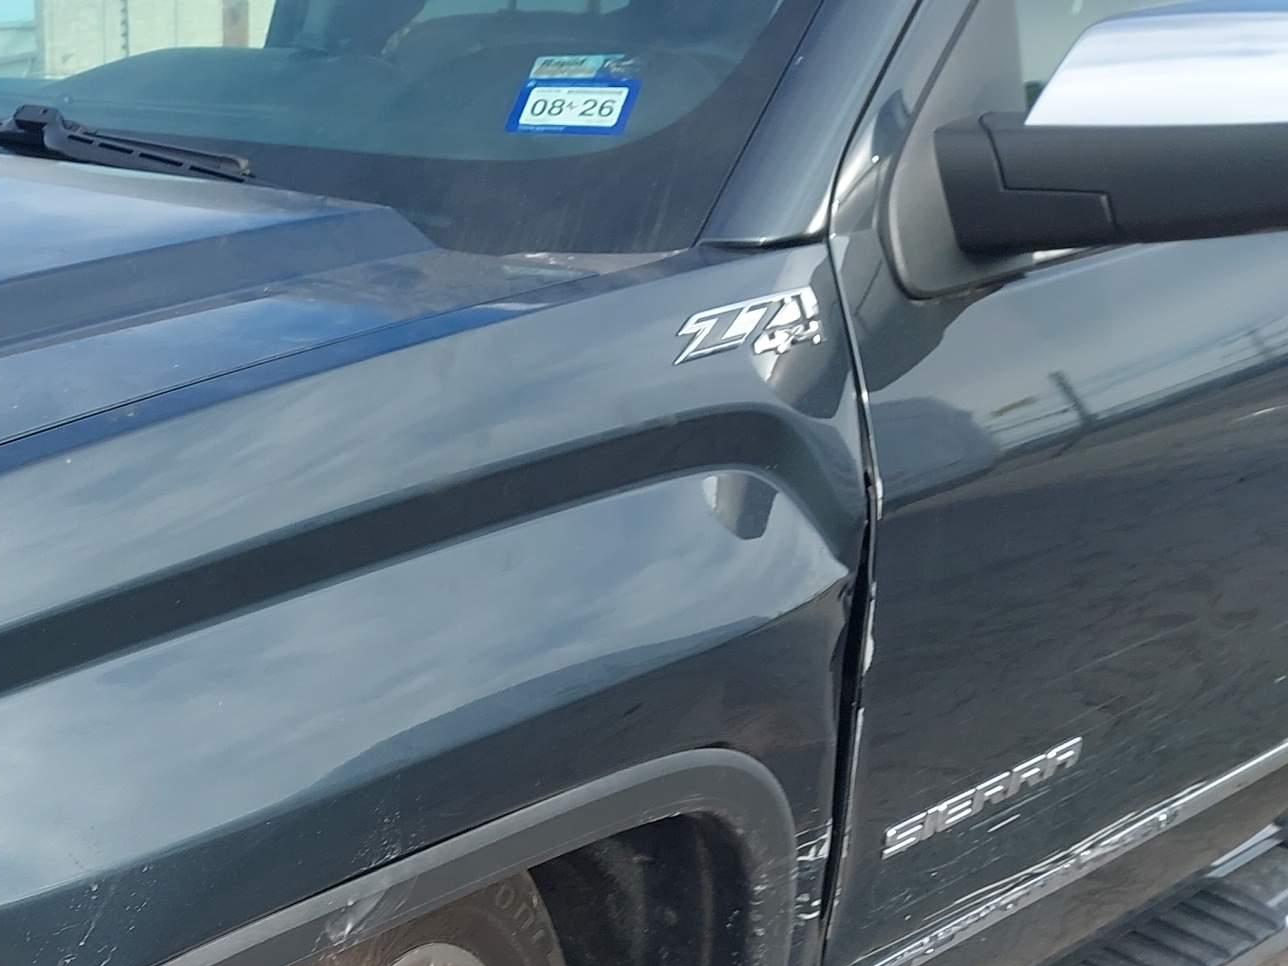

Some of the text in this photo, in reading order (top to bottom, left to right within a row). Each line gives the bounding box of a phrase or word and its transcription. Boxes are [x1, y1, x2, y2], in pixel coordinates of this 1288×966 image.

[530, 98, 617, 117] 08 26
[881, 736, 1083, 861] SIERRA
